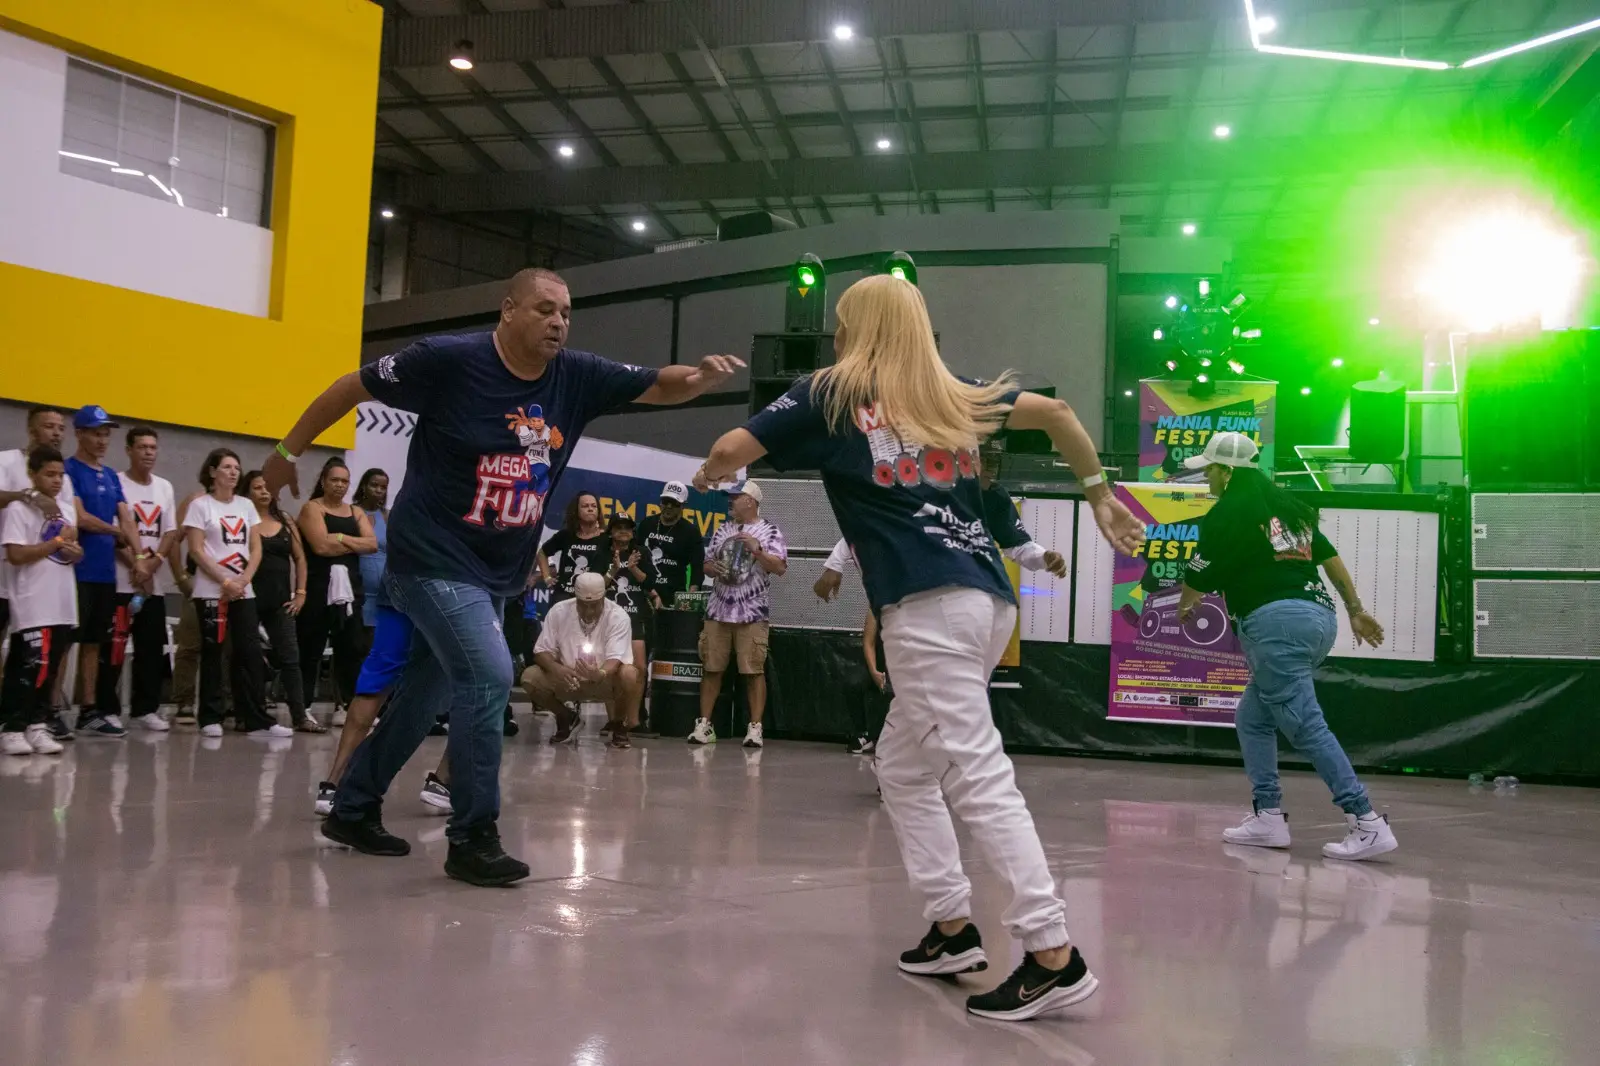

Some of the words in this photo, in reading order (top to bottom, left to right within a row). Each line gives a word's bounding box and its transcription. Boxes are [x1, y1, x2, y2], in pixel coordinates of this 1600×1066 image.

[1157, 415, 1212, 430] MANIA
[1216, 416, 1263, 431] FUNK
[1154, 429, 1263, 447] FESTL
[1171, 447, 1194, 462] 05
[480, 455, 529, 479] MEGA
[467, 475, 545, 525] FUN
[648, 532, 675, 544] DANCE
[1151, 561, 1178, 578] 05
